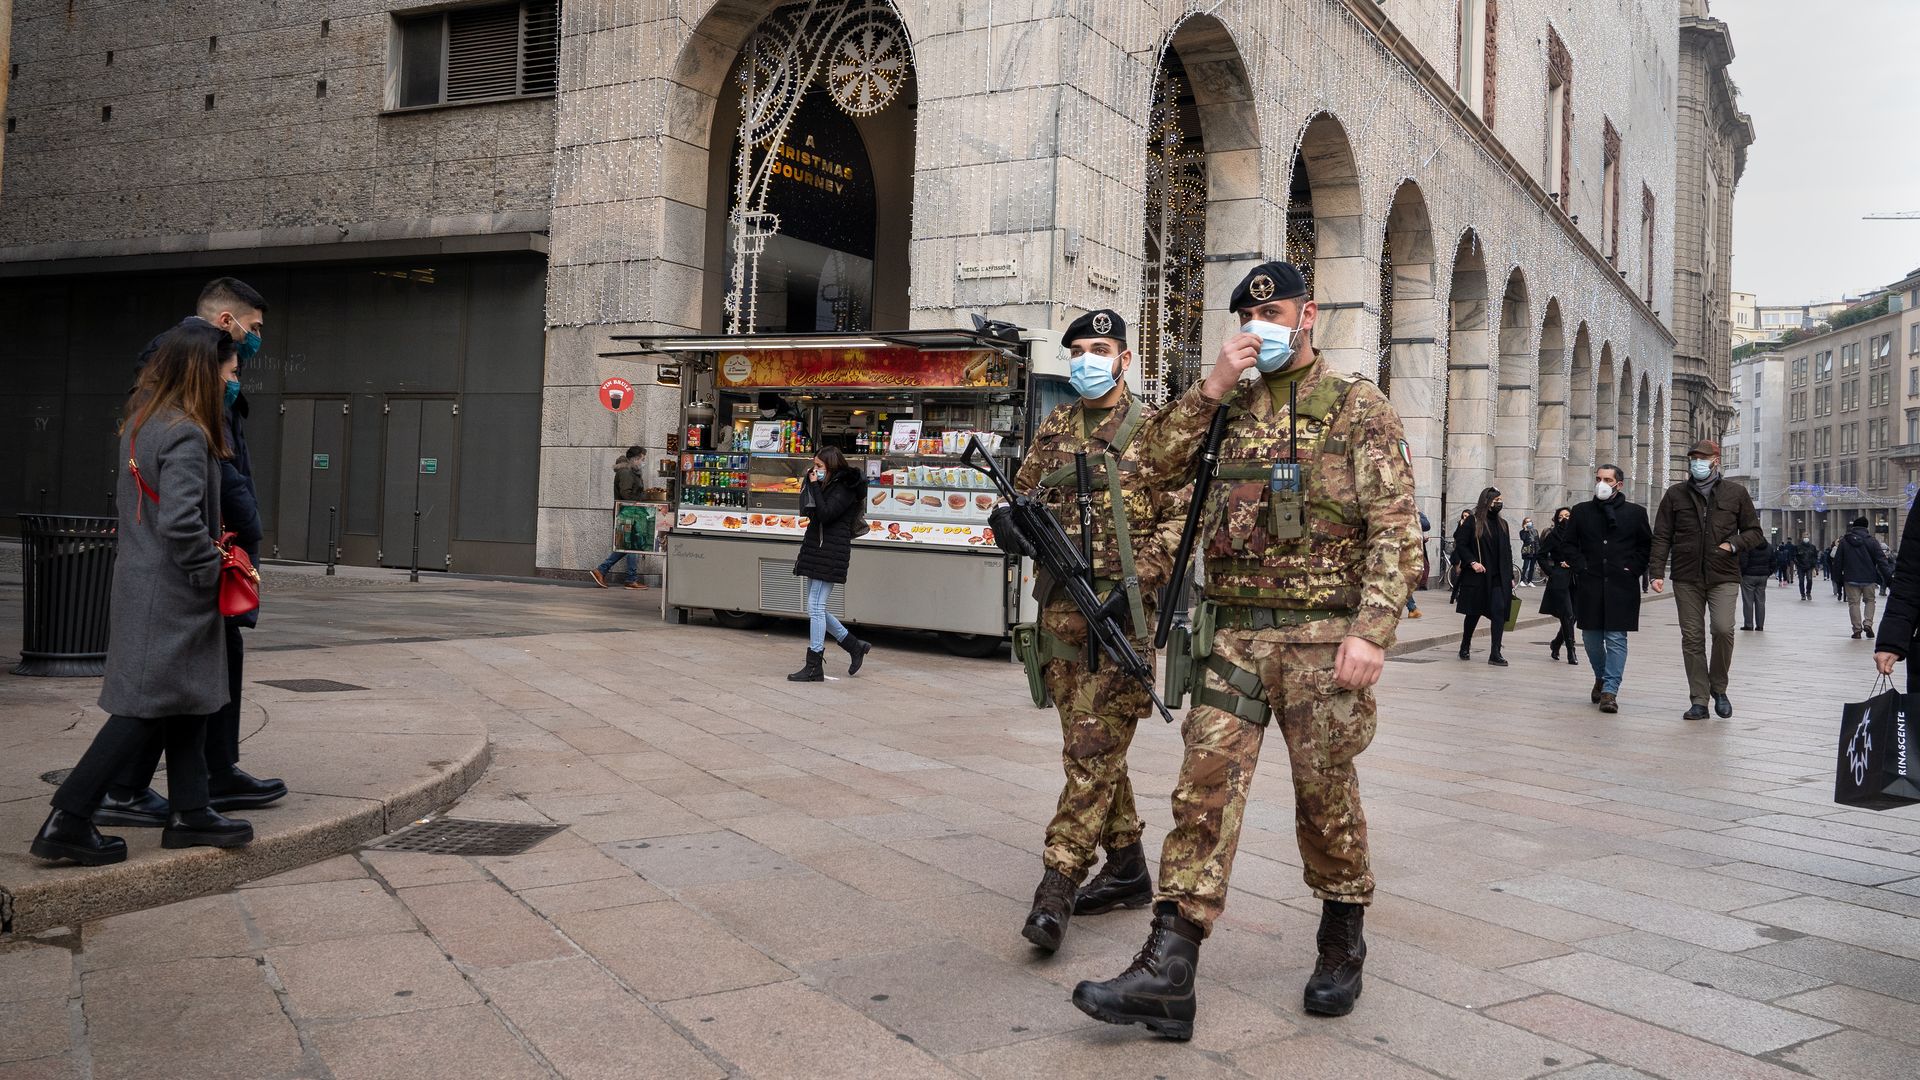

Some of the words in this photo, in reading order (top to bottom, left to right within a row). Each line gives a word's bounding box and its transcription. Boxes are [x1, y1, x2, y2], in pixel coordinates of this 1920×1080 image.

[805, 134, 816, 149] A
[763, 139, 853, 180] CHRISTMAS
[772, 161, 844, 195] JOURNEY
[602, 381, 613, 390] VIN
[911, 525, 932, 533] HOT
[943, 526, 972, 535] DOG
[1897, 711, 1907, 776] RINASCENTE
